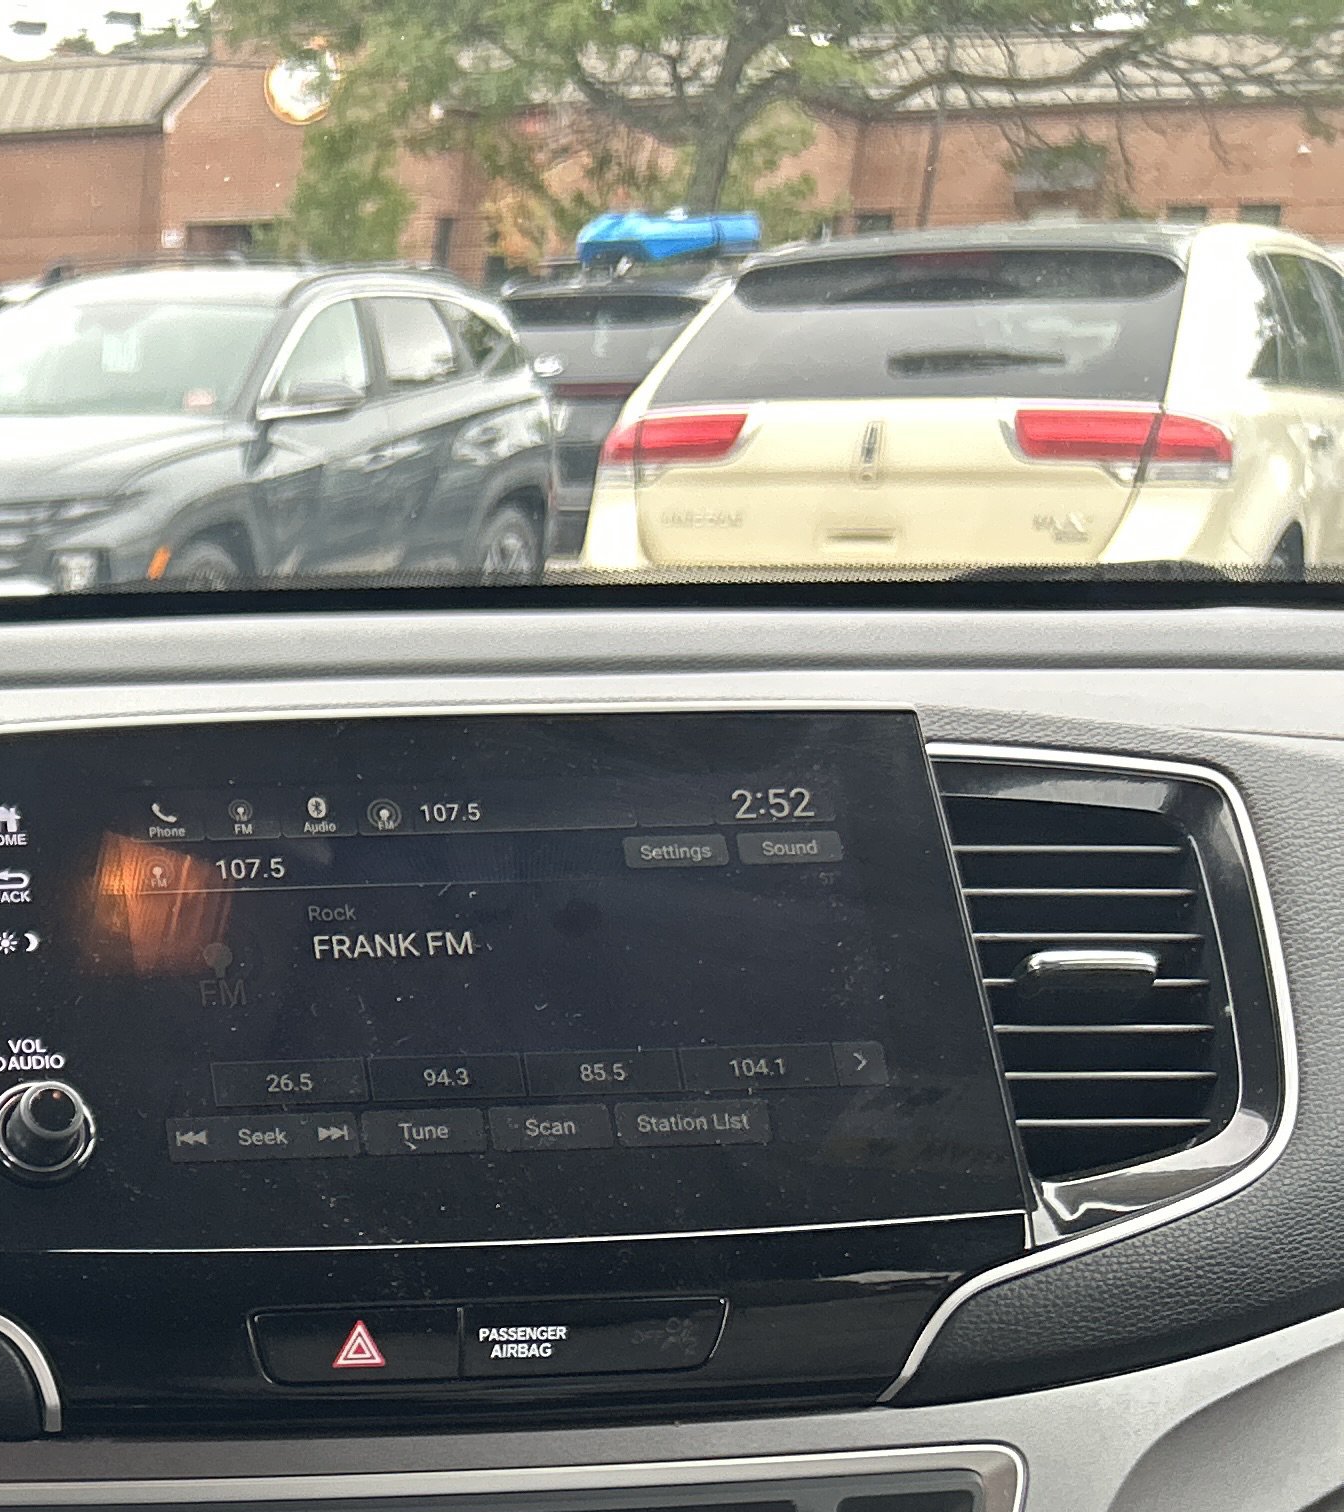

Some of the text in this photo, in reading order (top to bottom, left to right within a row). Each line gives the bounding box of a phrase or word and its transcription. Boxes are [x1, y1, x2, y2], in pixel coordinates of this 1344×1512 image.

[419, 802, 482, 824] 107.5
[731, 787, 817, 821] 2:52
[148, 824, 186, 840] Phone
[234, 822, 253, 836] FM
[303, 820, 337, 835] Audio
[640, 842, 713, 863] Settings
[761, 837, 818, 858] Sound
[214, 857, 286, 881] 107.5
[308, 903, 357, 922] Rock
[312, 931, 475, 961] FRANK FM
[199, 979, 247, 1007] FM
[8, 1037, 47, 1054] VOL
[8, 1054, 65, 1071] AUDIO
[579, 1062, 627, 1083] 85.5
[728, 1057, 787, 1079] 104.1
[266, 1073, 313, 1093] 26.5
[423, 1067, 470, 1088] 94.3
[398, 1121, 449, 1142] Tune
[524, 1117, 576, 1138] Scan
[637, 1112, 751, 1134] Station List
[237, 1128, 289, 1147] Seek
[478, 1325, 568, 1343] PASSENGER
[490, 1342, 554, 1360] AIRBAG
